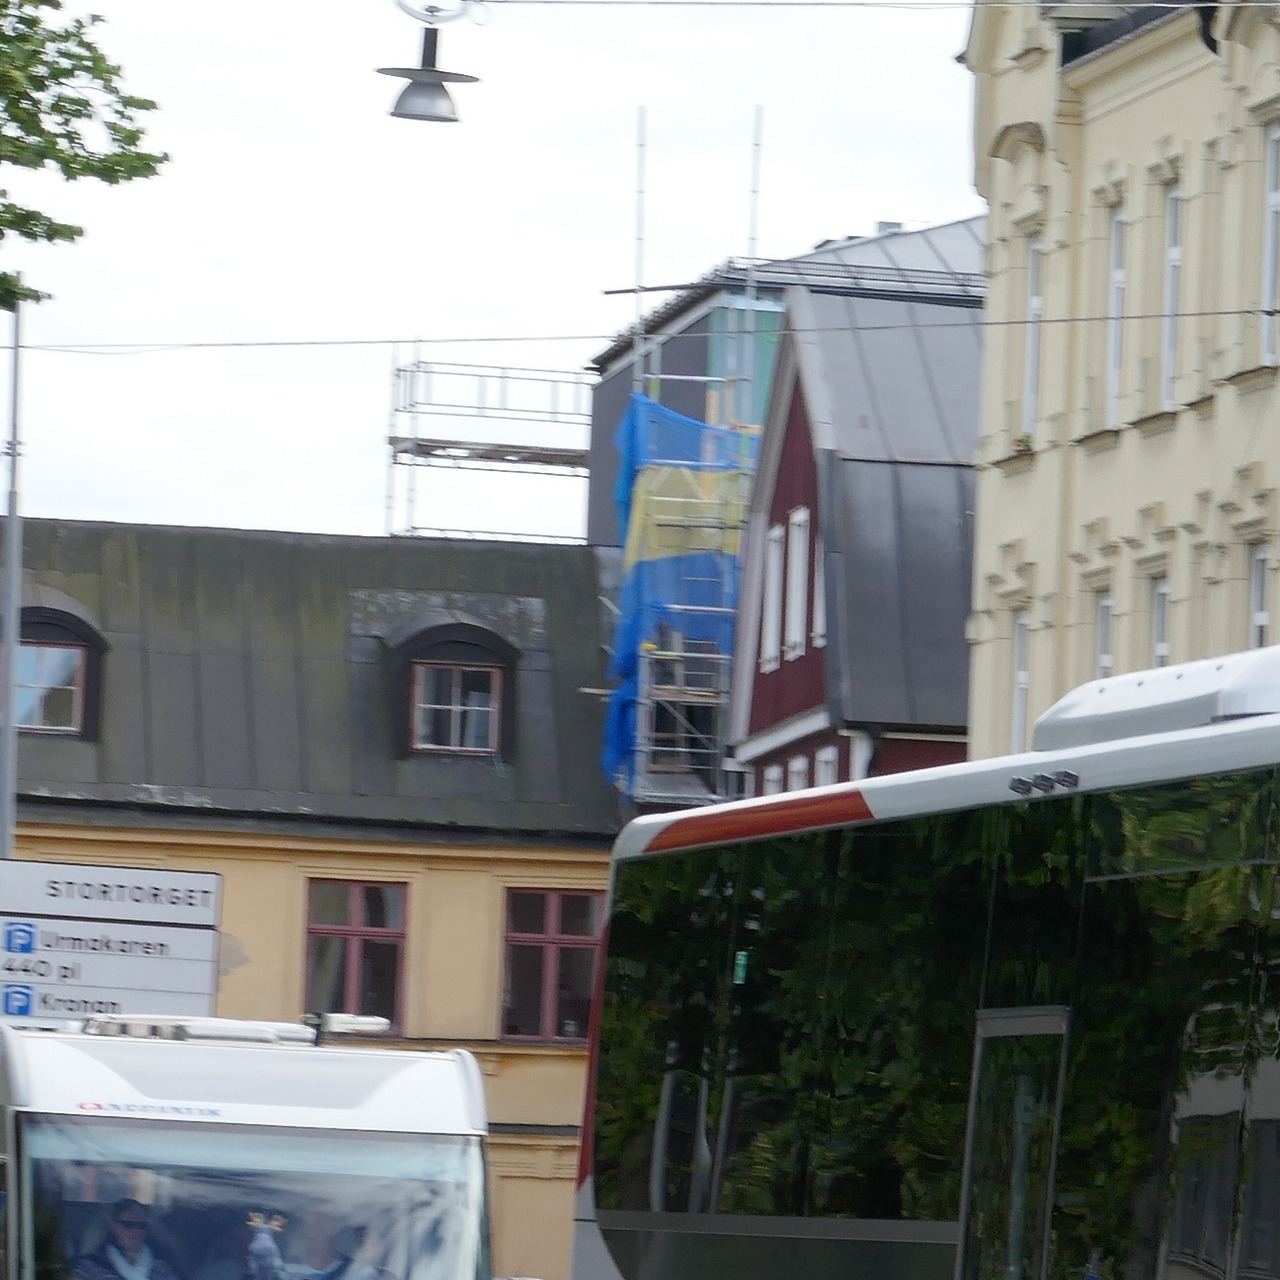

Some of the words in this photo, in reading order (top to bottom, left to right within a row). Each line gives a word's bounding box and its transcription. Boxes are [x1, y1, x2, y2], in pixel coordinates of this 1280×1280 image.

[46, 879, 214, 908] STORTORGET
[40, 931, 170, 956] Urmakaren
[2, 958, 51, 978] 440
[38, 992, 122, 1014] Kronan
